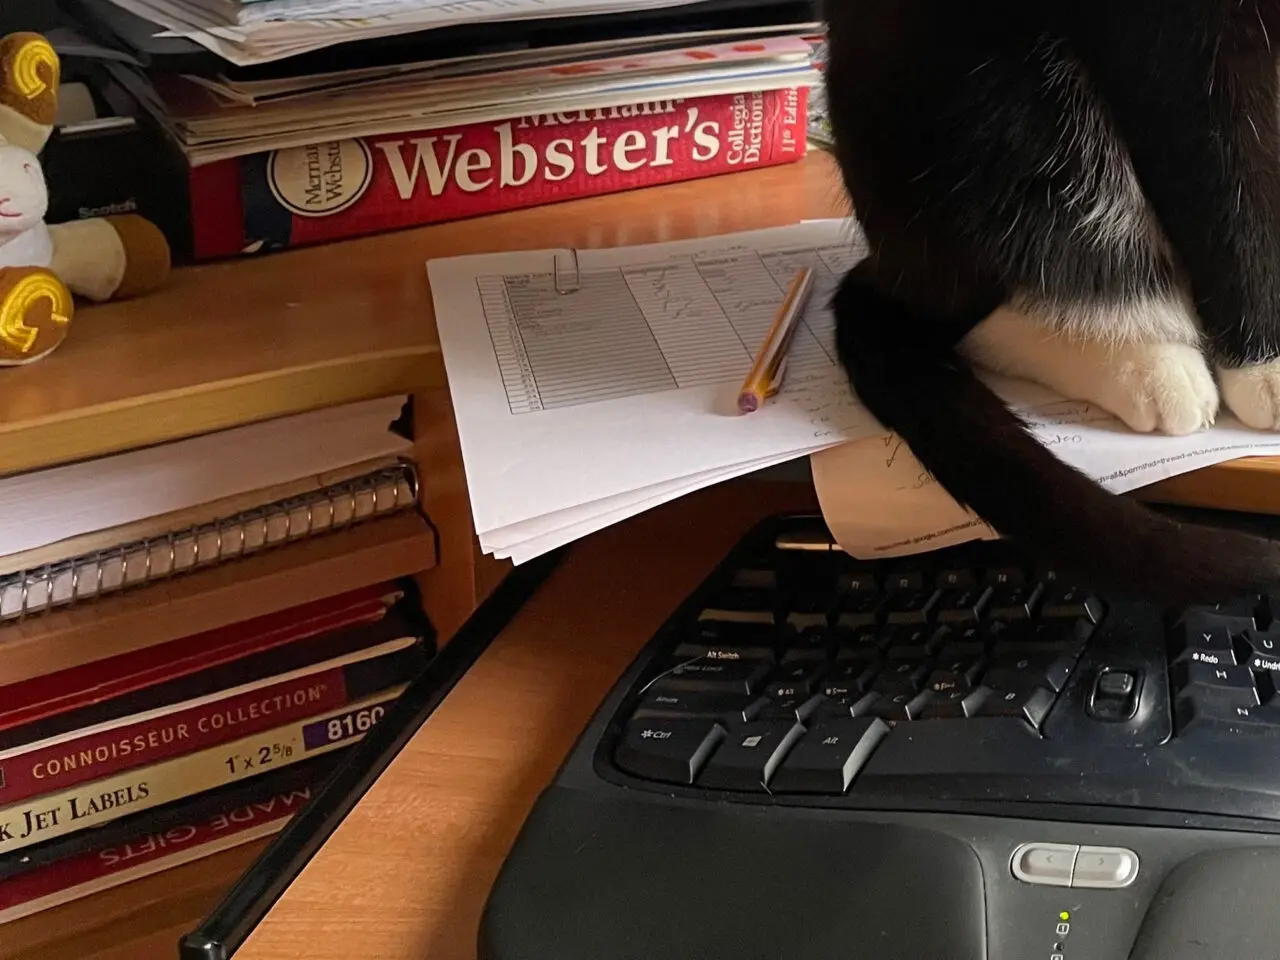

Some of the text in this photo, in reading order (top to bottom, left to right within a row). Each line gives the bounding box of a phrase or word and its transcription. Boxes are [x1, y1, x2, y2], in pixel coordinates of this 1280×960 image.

[376, 107, 720, 200] Webster's
[1202, 632, 1212, 642] Y
[1263, 640, 1274, 649] U
[1200, 653, 1218, 664] Redo
[327, 706, 386, 741] 8160
[653, 730, 672, 740] Ctrl
[822, 736, 839, 745] Alt
[32, 723, 189, 780] CONNOISSEUR
[244, 759, 255, 770] x
[100, 824, 197, 867] GIFTS
